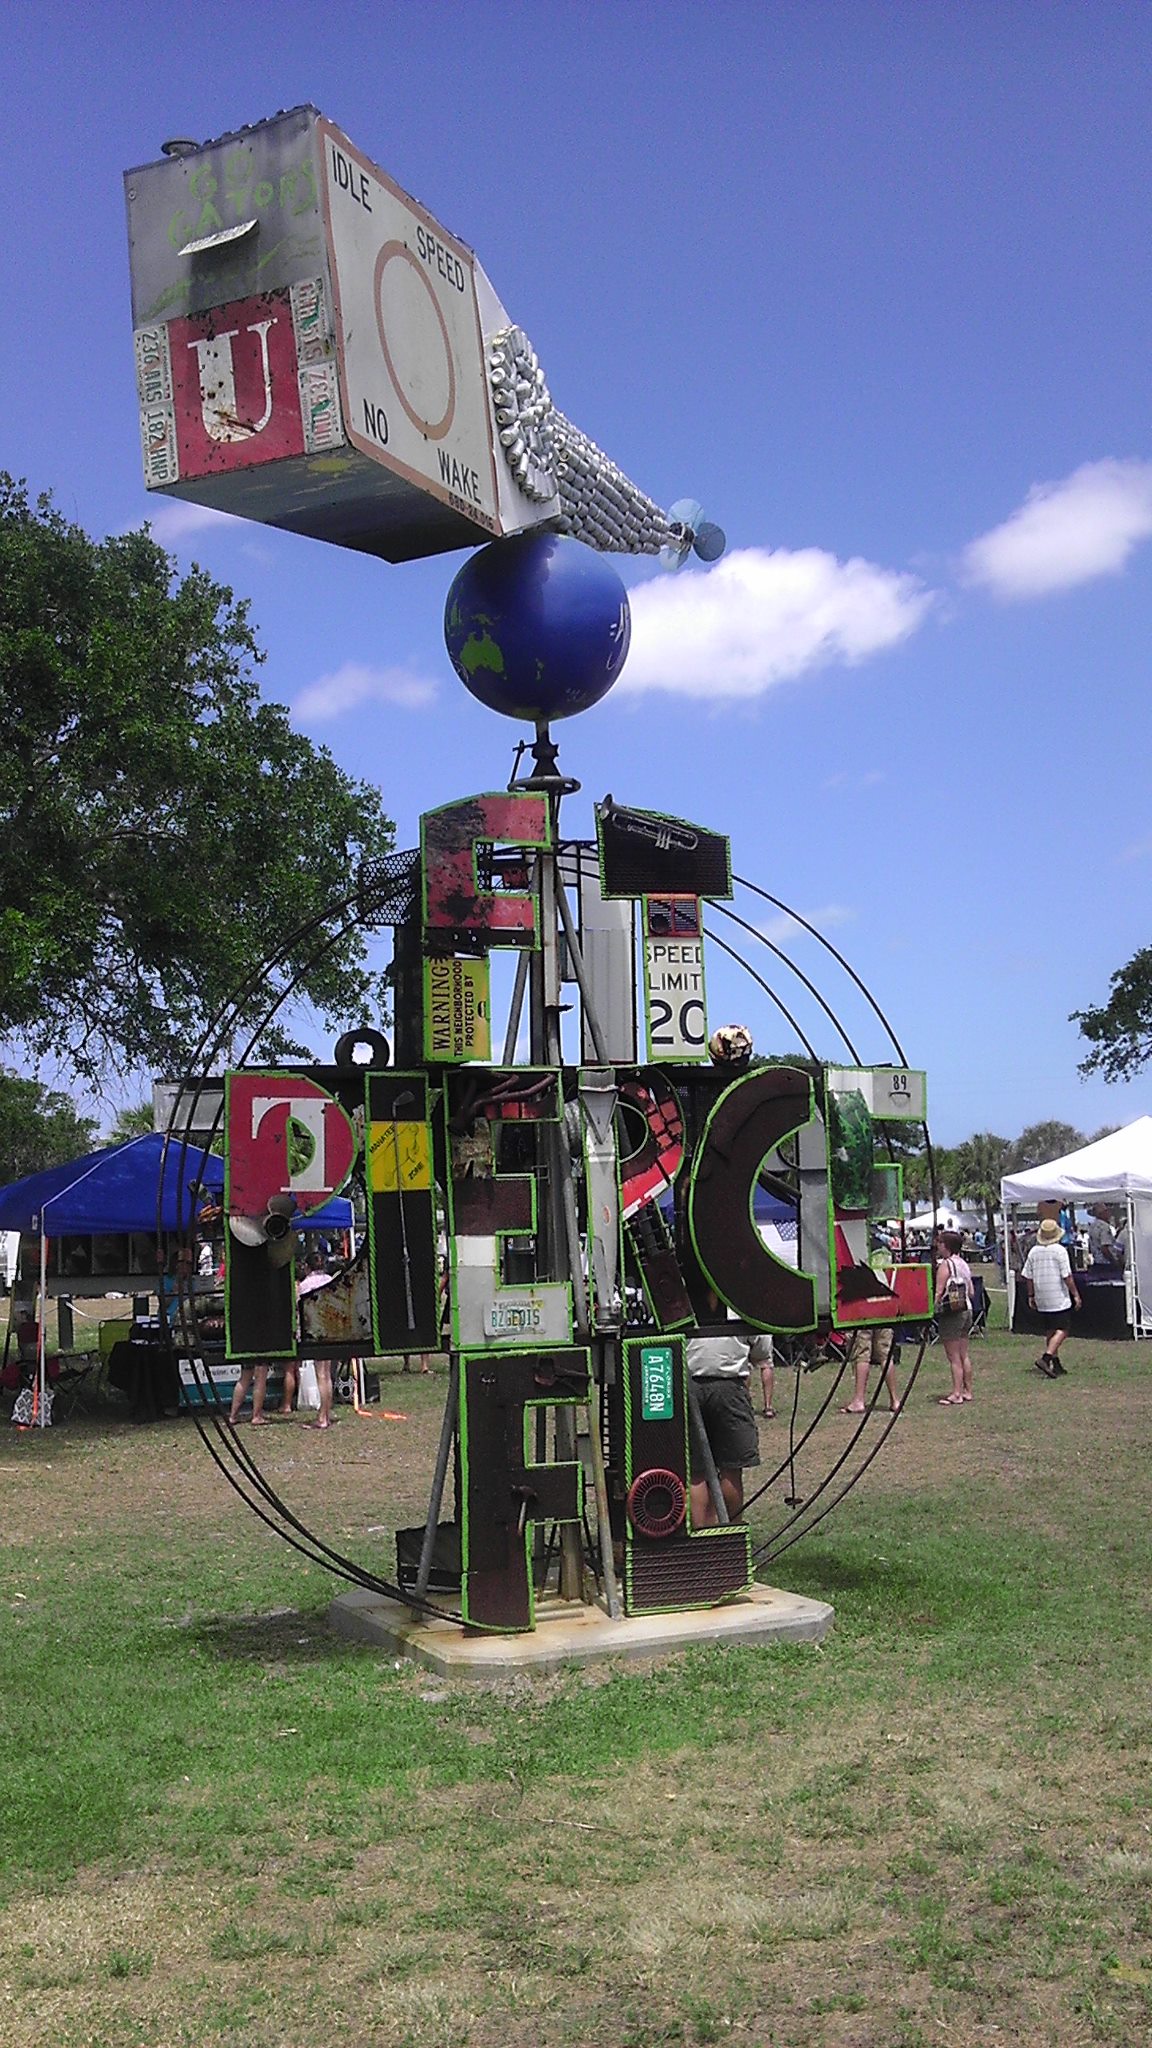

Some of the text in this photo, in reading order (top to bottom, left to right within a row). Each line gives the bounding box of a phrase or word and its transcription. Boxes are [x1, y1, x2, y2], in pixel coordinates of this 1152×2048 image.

[331, 146, 372, 213] IDLE
[416, 226, 465, 293] SPEED
[141, 330, 160, 364] 236
[188, 317, 278, 443] U
[146, 410, 168, 483] 182 HNP
[363, 398, 389, 445] NO
[437, 447, 482, 505] WAKE
[431, 966, 450, 1051] WARNING
[453, 960, 463, 1057] THIS NEIGHBORHOOD
[464, 974, 474, 1047] PROTECTED BY
[648, 973, 701, 991] LIMIT
[650, 999, 705, 1046] 20
[892, 1074, 907, 1091] 89
[408, 1161, 424, 1180] ZONE
[648, 1355, 665, 1412] A7648N
